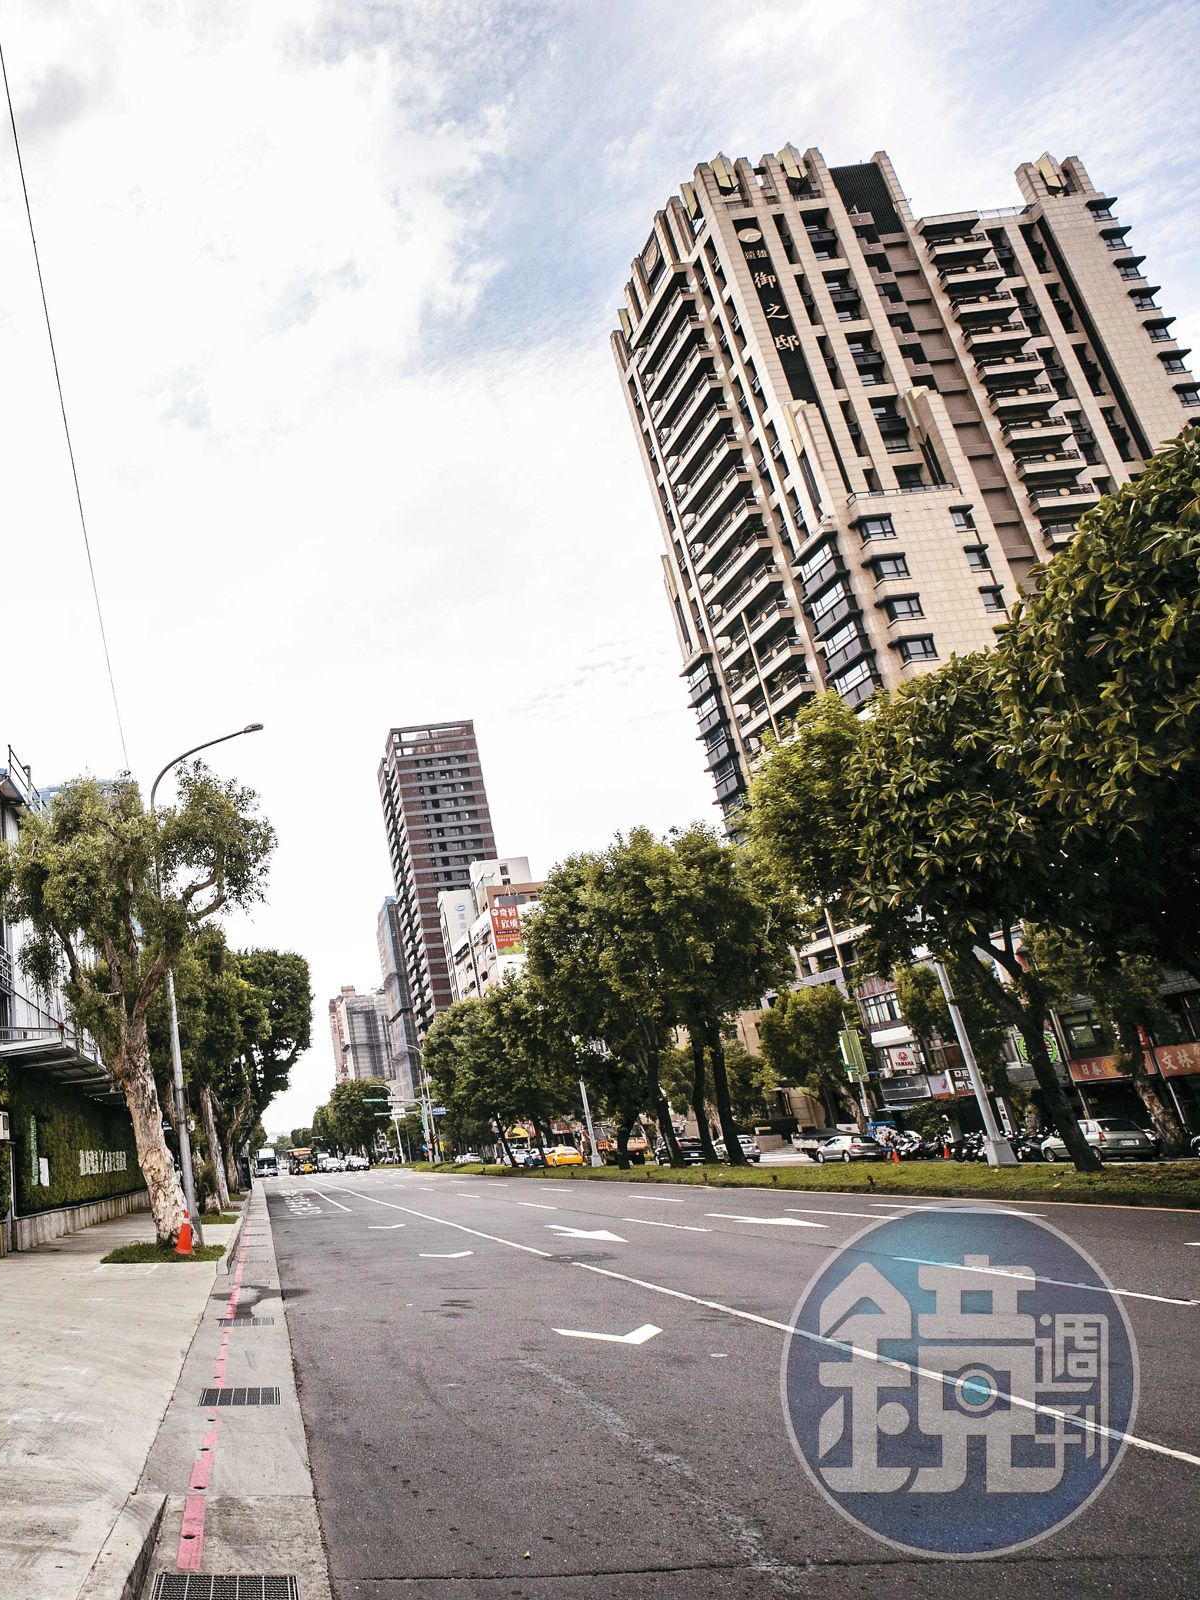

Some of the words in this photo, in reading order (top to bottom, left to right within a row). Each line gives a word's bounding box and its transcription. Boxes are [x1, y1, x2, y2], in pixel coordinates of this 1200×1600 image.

[744, 250, 768, 260] 遠雄
[754, 271, 801, 351] 御之邸
